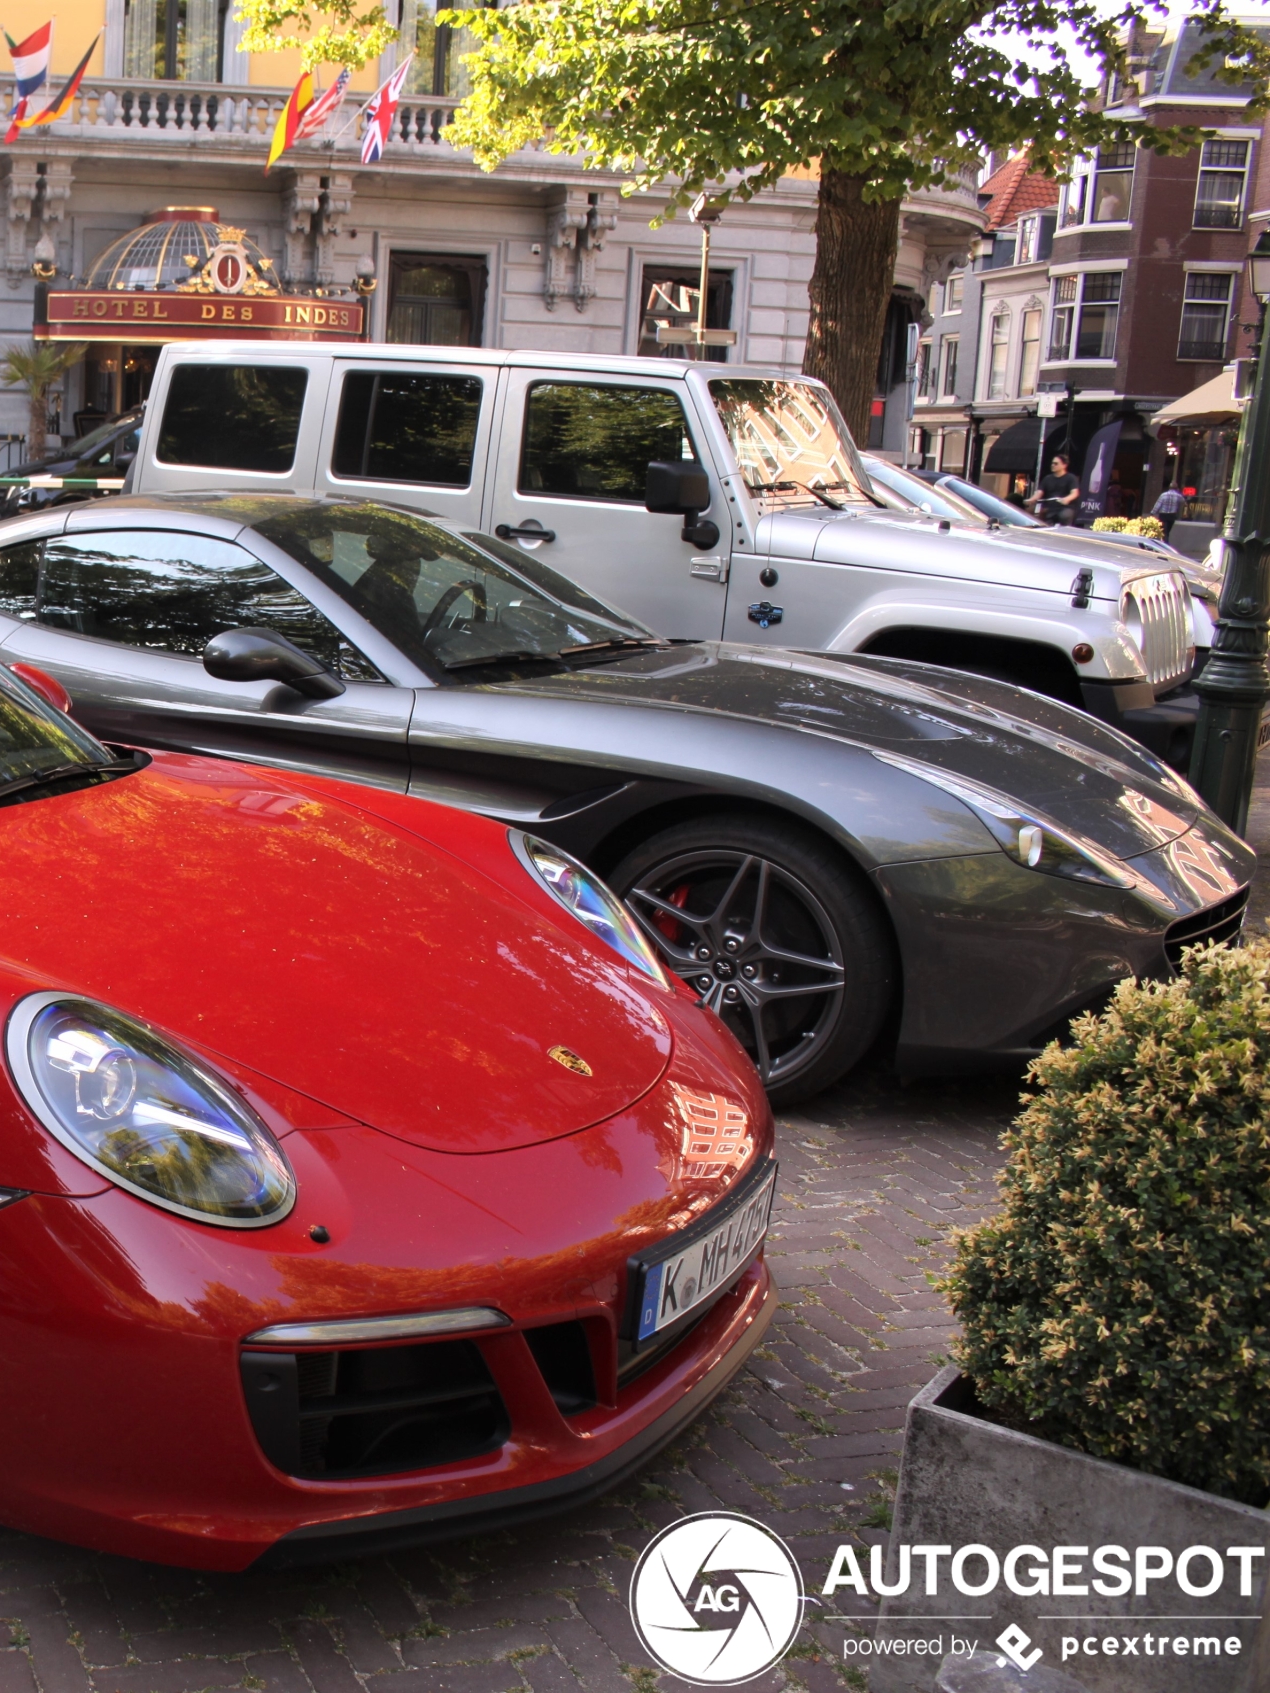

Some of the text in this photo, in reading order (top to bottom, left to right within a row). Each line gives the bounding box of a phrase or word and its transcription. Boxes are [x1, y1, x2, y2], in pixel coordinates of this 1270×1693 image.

[72, 299, 350, 326] HOTEL DES INDES
[659, 1256, 684, 1319] K
[644, 1308, 652, 1325] D
